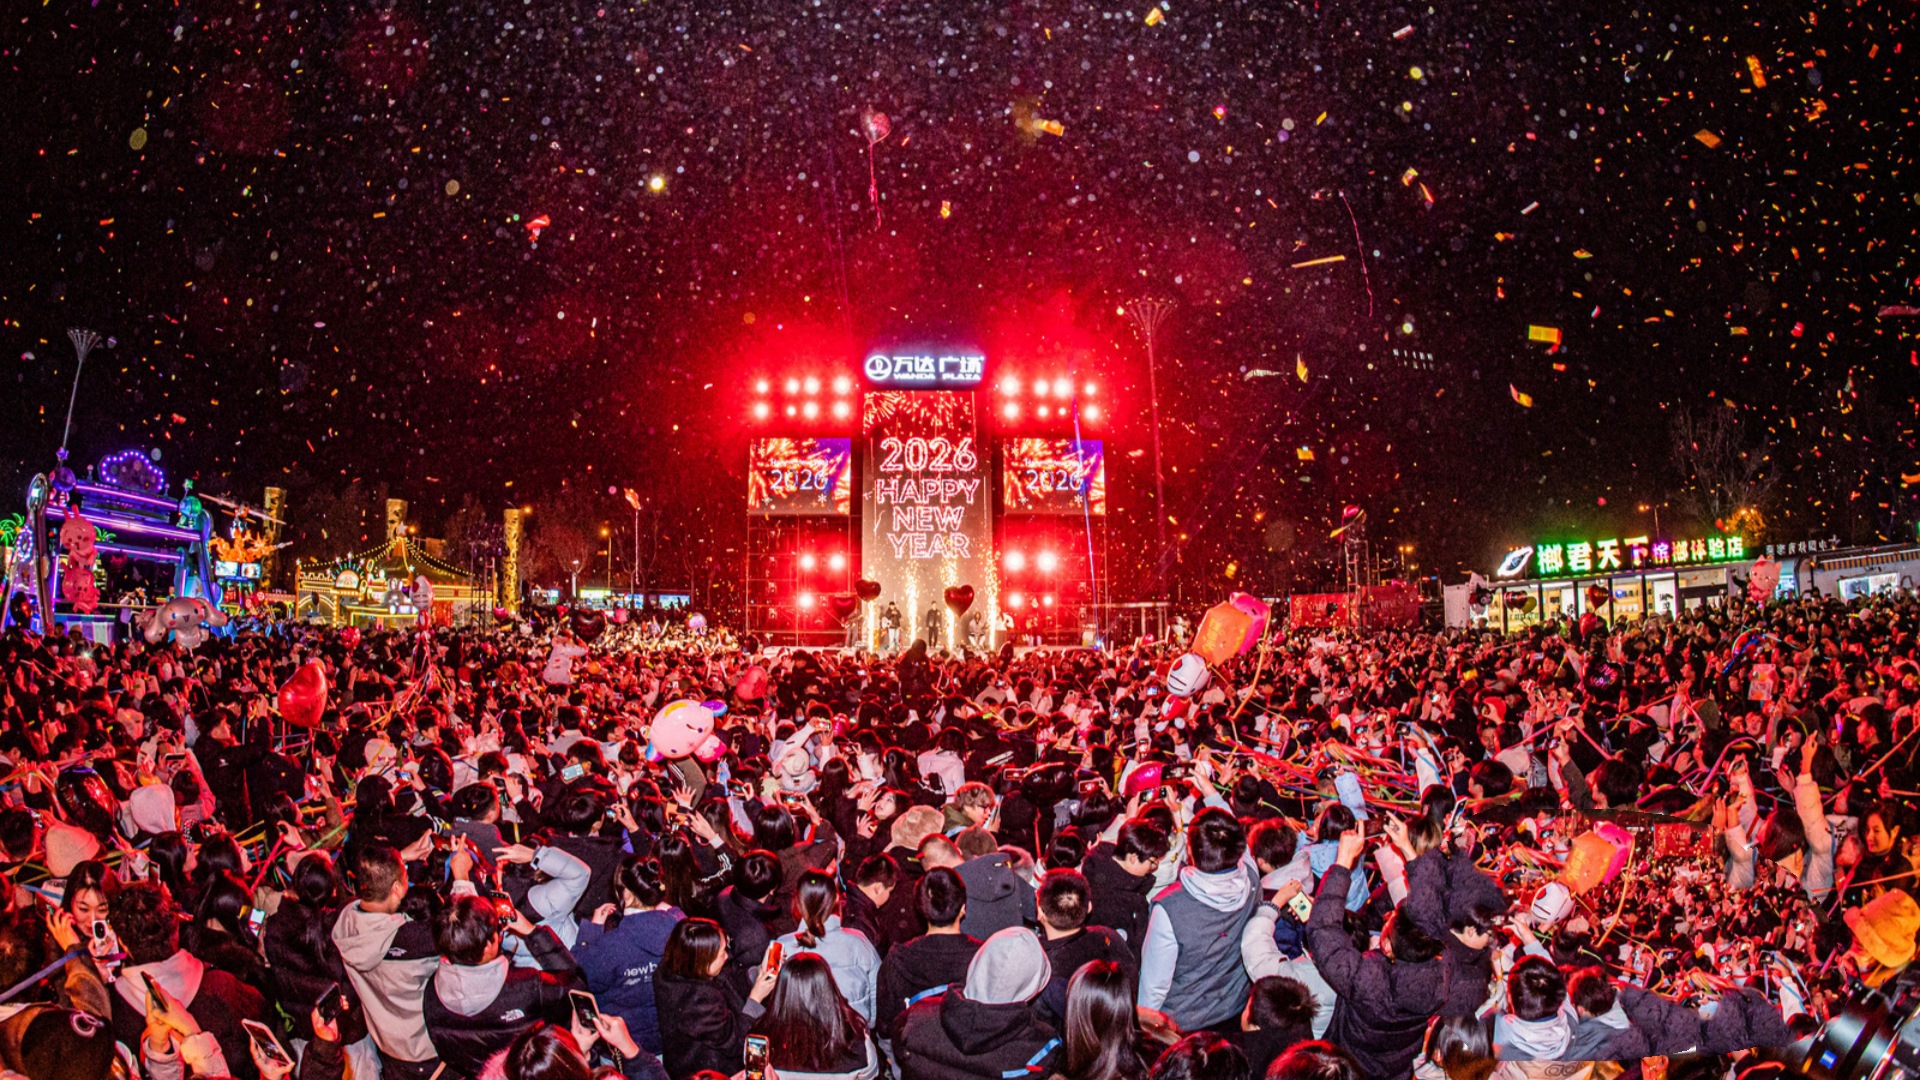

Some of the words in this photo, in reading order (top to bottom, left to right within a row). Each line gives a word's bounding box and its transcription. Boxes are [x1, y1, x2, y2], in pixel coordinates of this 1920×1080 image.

[893, 356, 982, 373] 万达广场
[880, 437, 977, 471] 2026
[770, 469, 829, 490] 2026
[876, 479, 980, 504] HAPPY
[1026, 469, 1084, 491] 2026
[892, 506, 965, 531] NEW
[887, 532, 971, 558] YEAR
